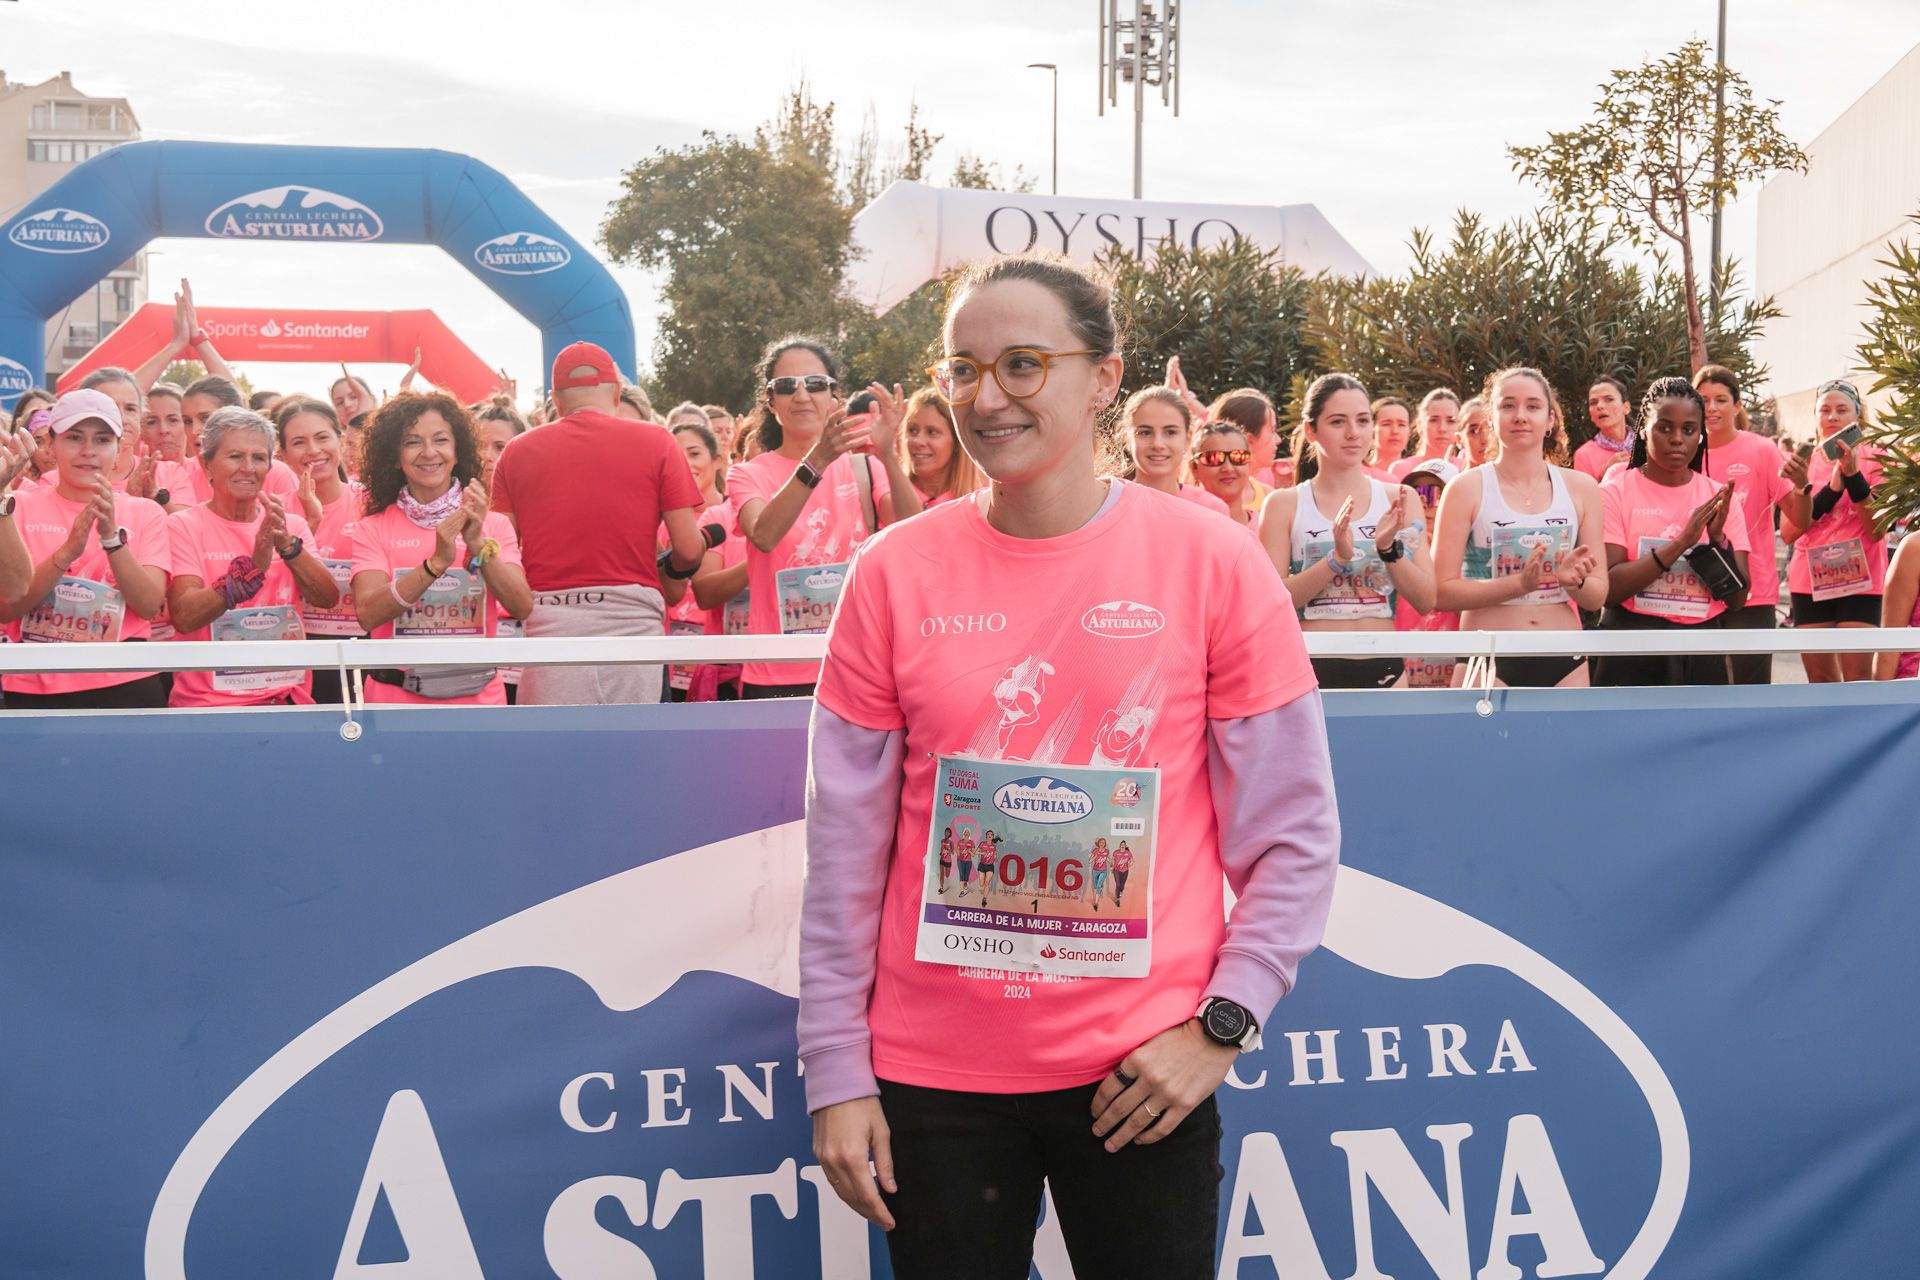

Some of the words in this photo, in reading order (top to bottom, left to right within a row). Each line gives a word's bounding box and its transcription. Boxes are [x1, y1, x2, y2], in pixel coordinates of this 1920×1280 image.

[222, 213, 371, 237] ASTURIANA
[16, 224, 101, 244] ASTURIANA
[985, 206, 1240, 261] OYSHO
[482, 248, 564, 265] ASTURIANA
[204, 320, 258, 339] Sports
[283, 321, 370, 339] Santander
[1333, 574, 1363, 588] 016
[1665, 573, 1697, 586] 016
[424, 605, 459, 618] 016
[811, 601, 836, 617] 01
[51, 613, 89, 631] 016
[920, 612, 1007, 637] OYSHO
[1088, 613, 1159, 629] ASTURIANA
[1425, 664, 1454, 677] 016
[948, 776, 979, 791] SUMA
[953, 794, 981, 804] Zaragoza
[1000, 790, 1085, 814] ASTURIANA
[1015, 790, 1048, 798] CENTRAL
[999, 853, 1084, 892] 016
[1031, 899, 1038, 914] 1
[947, 909, 993, 924] CARRERA
[996, 914, 1008, 926] DE
[1011, 916, 1024, 928] LA
[1027, 918, 1062, 931] MUJER
[1072, 922, 1127, 934] ZARAGOZA
[943, 933, 1014, 955] OYSHO
[1058, 947, 1126, 962] Santander
[958, 965, 1005, 981] CARRERA
[1003, 984, 1032, 999] 2024
[559, 1058, 805, 1133] CEN
